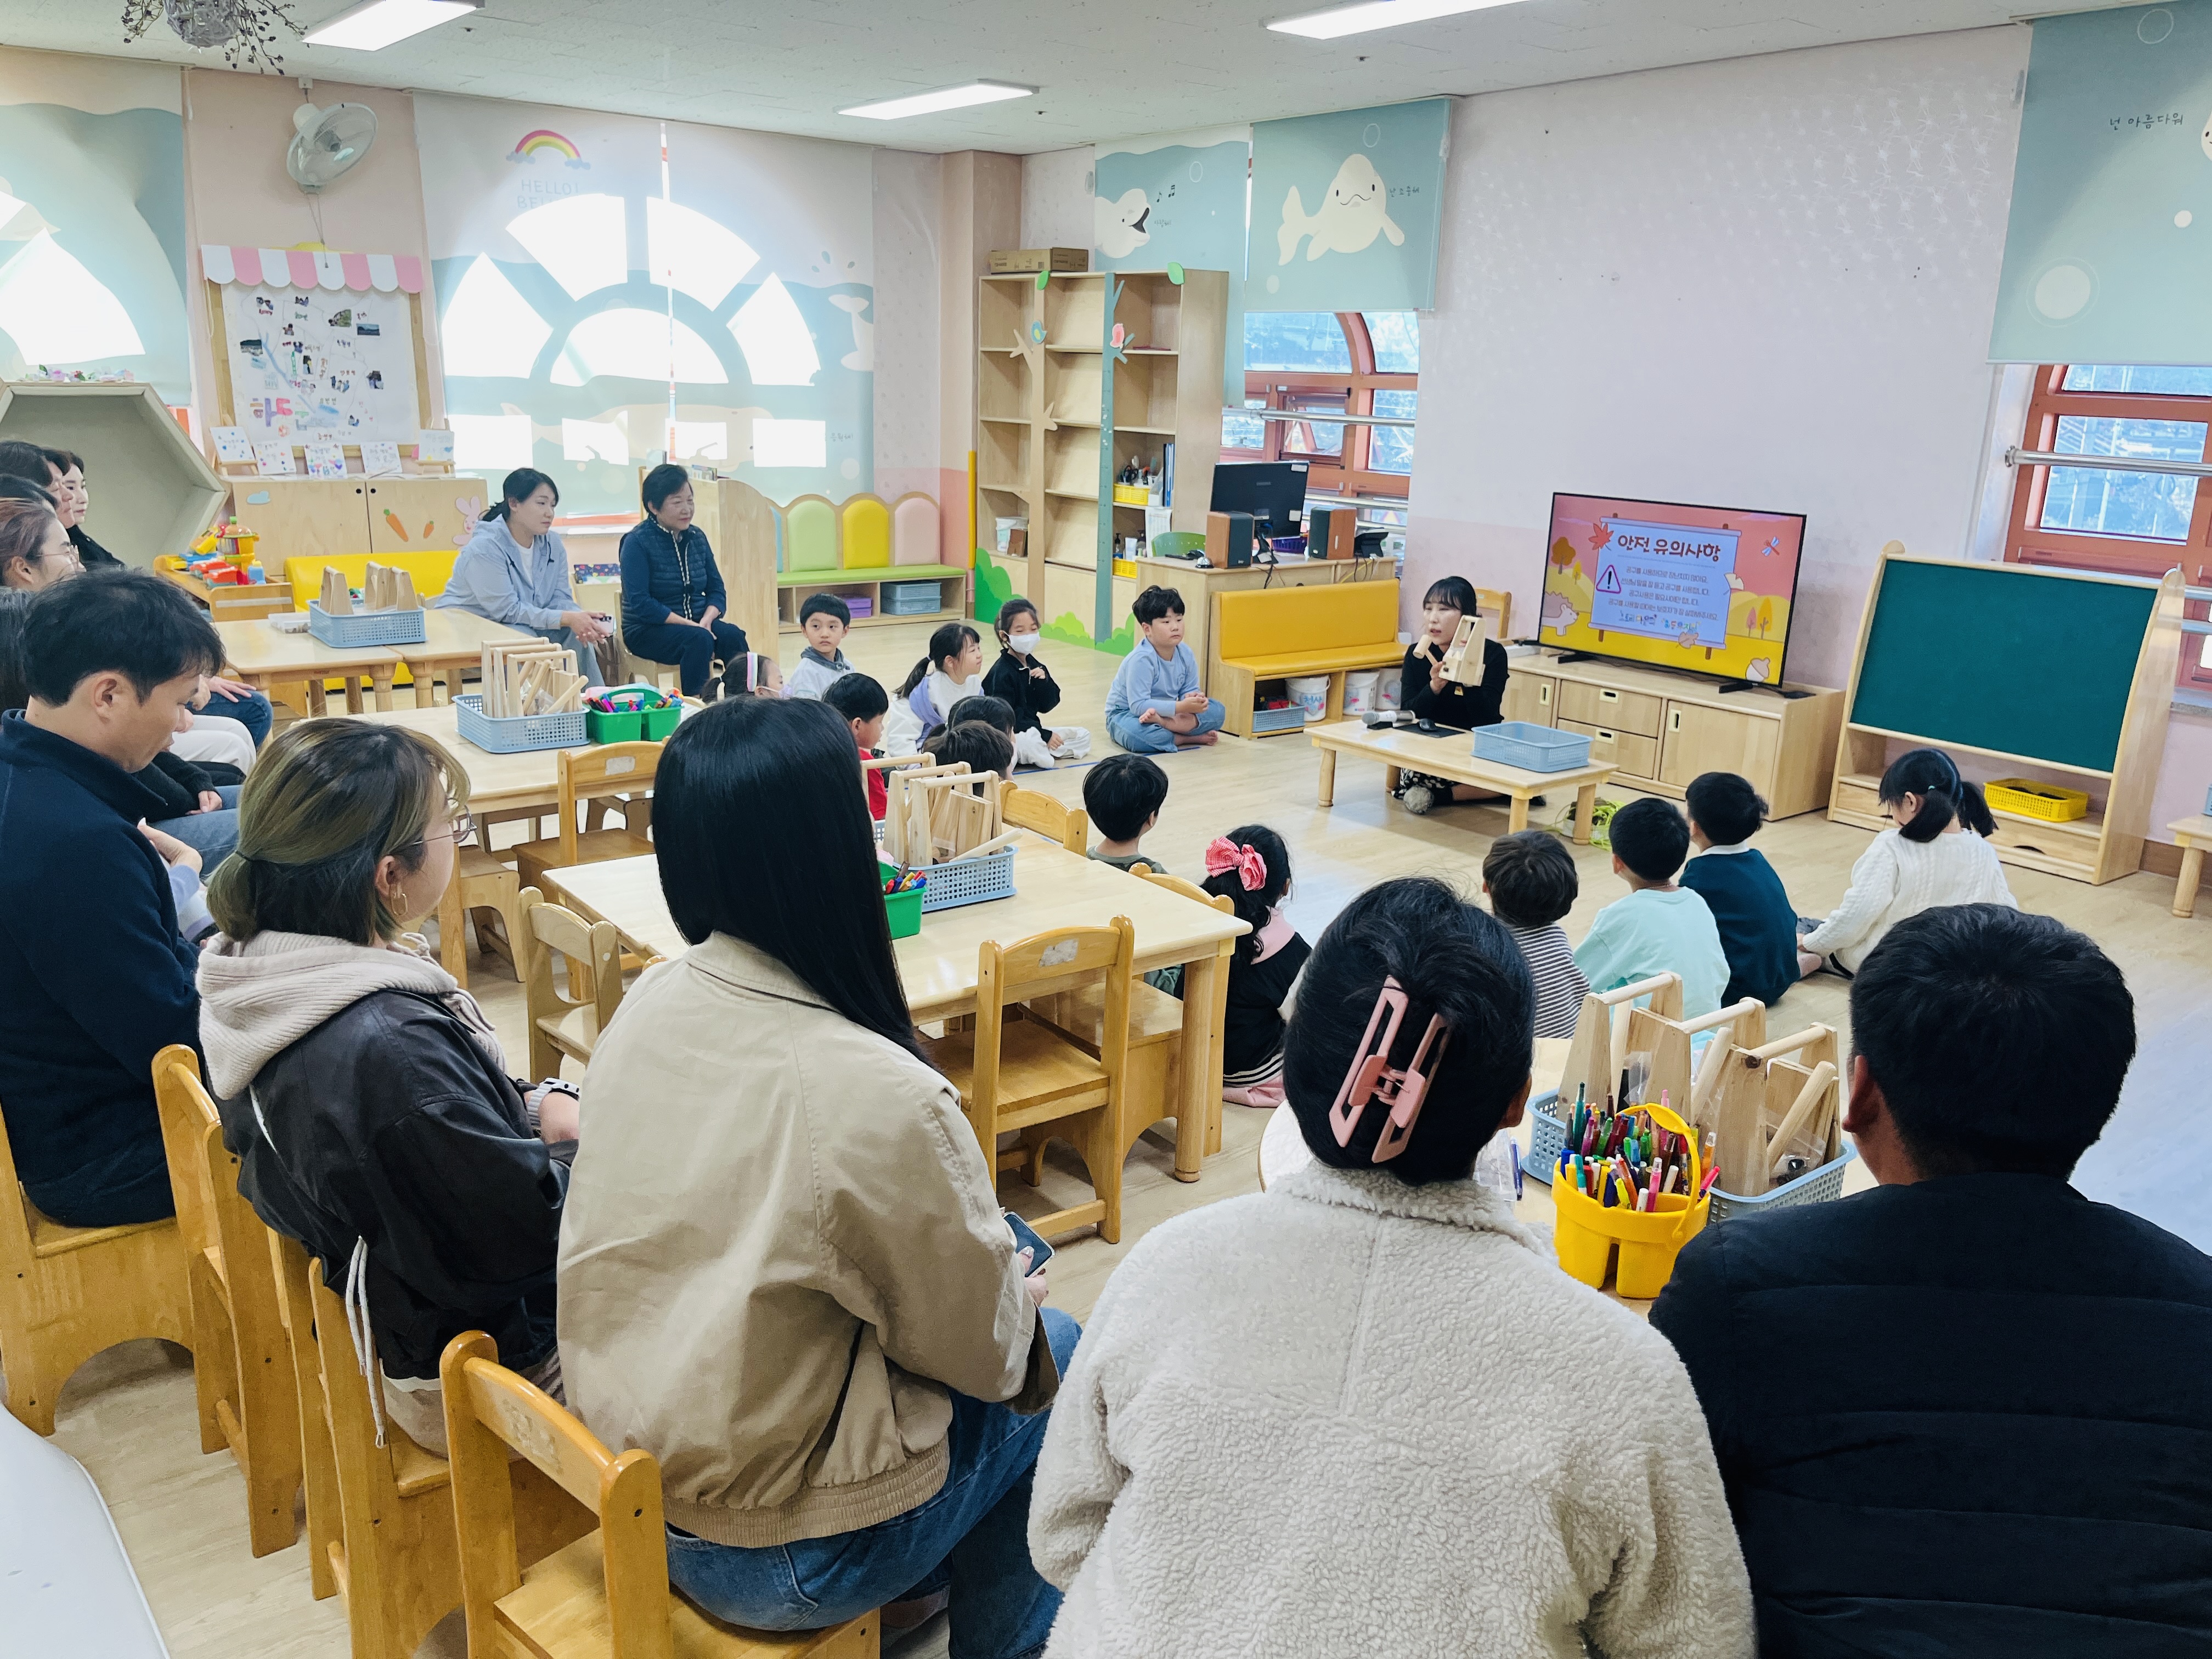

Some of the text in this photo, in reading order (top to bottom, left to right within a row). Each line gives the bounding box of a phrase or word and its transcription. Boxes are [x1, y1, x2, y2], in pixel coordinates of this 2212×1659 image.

[2110, 112, 2183, 131] 넌 아름다워
[1618, 535, 1721, 562] 안전 유의사항
